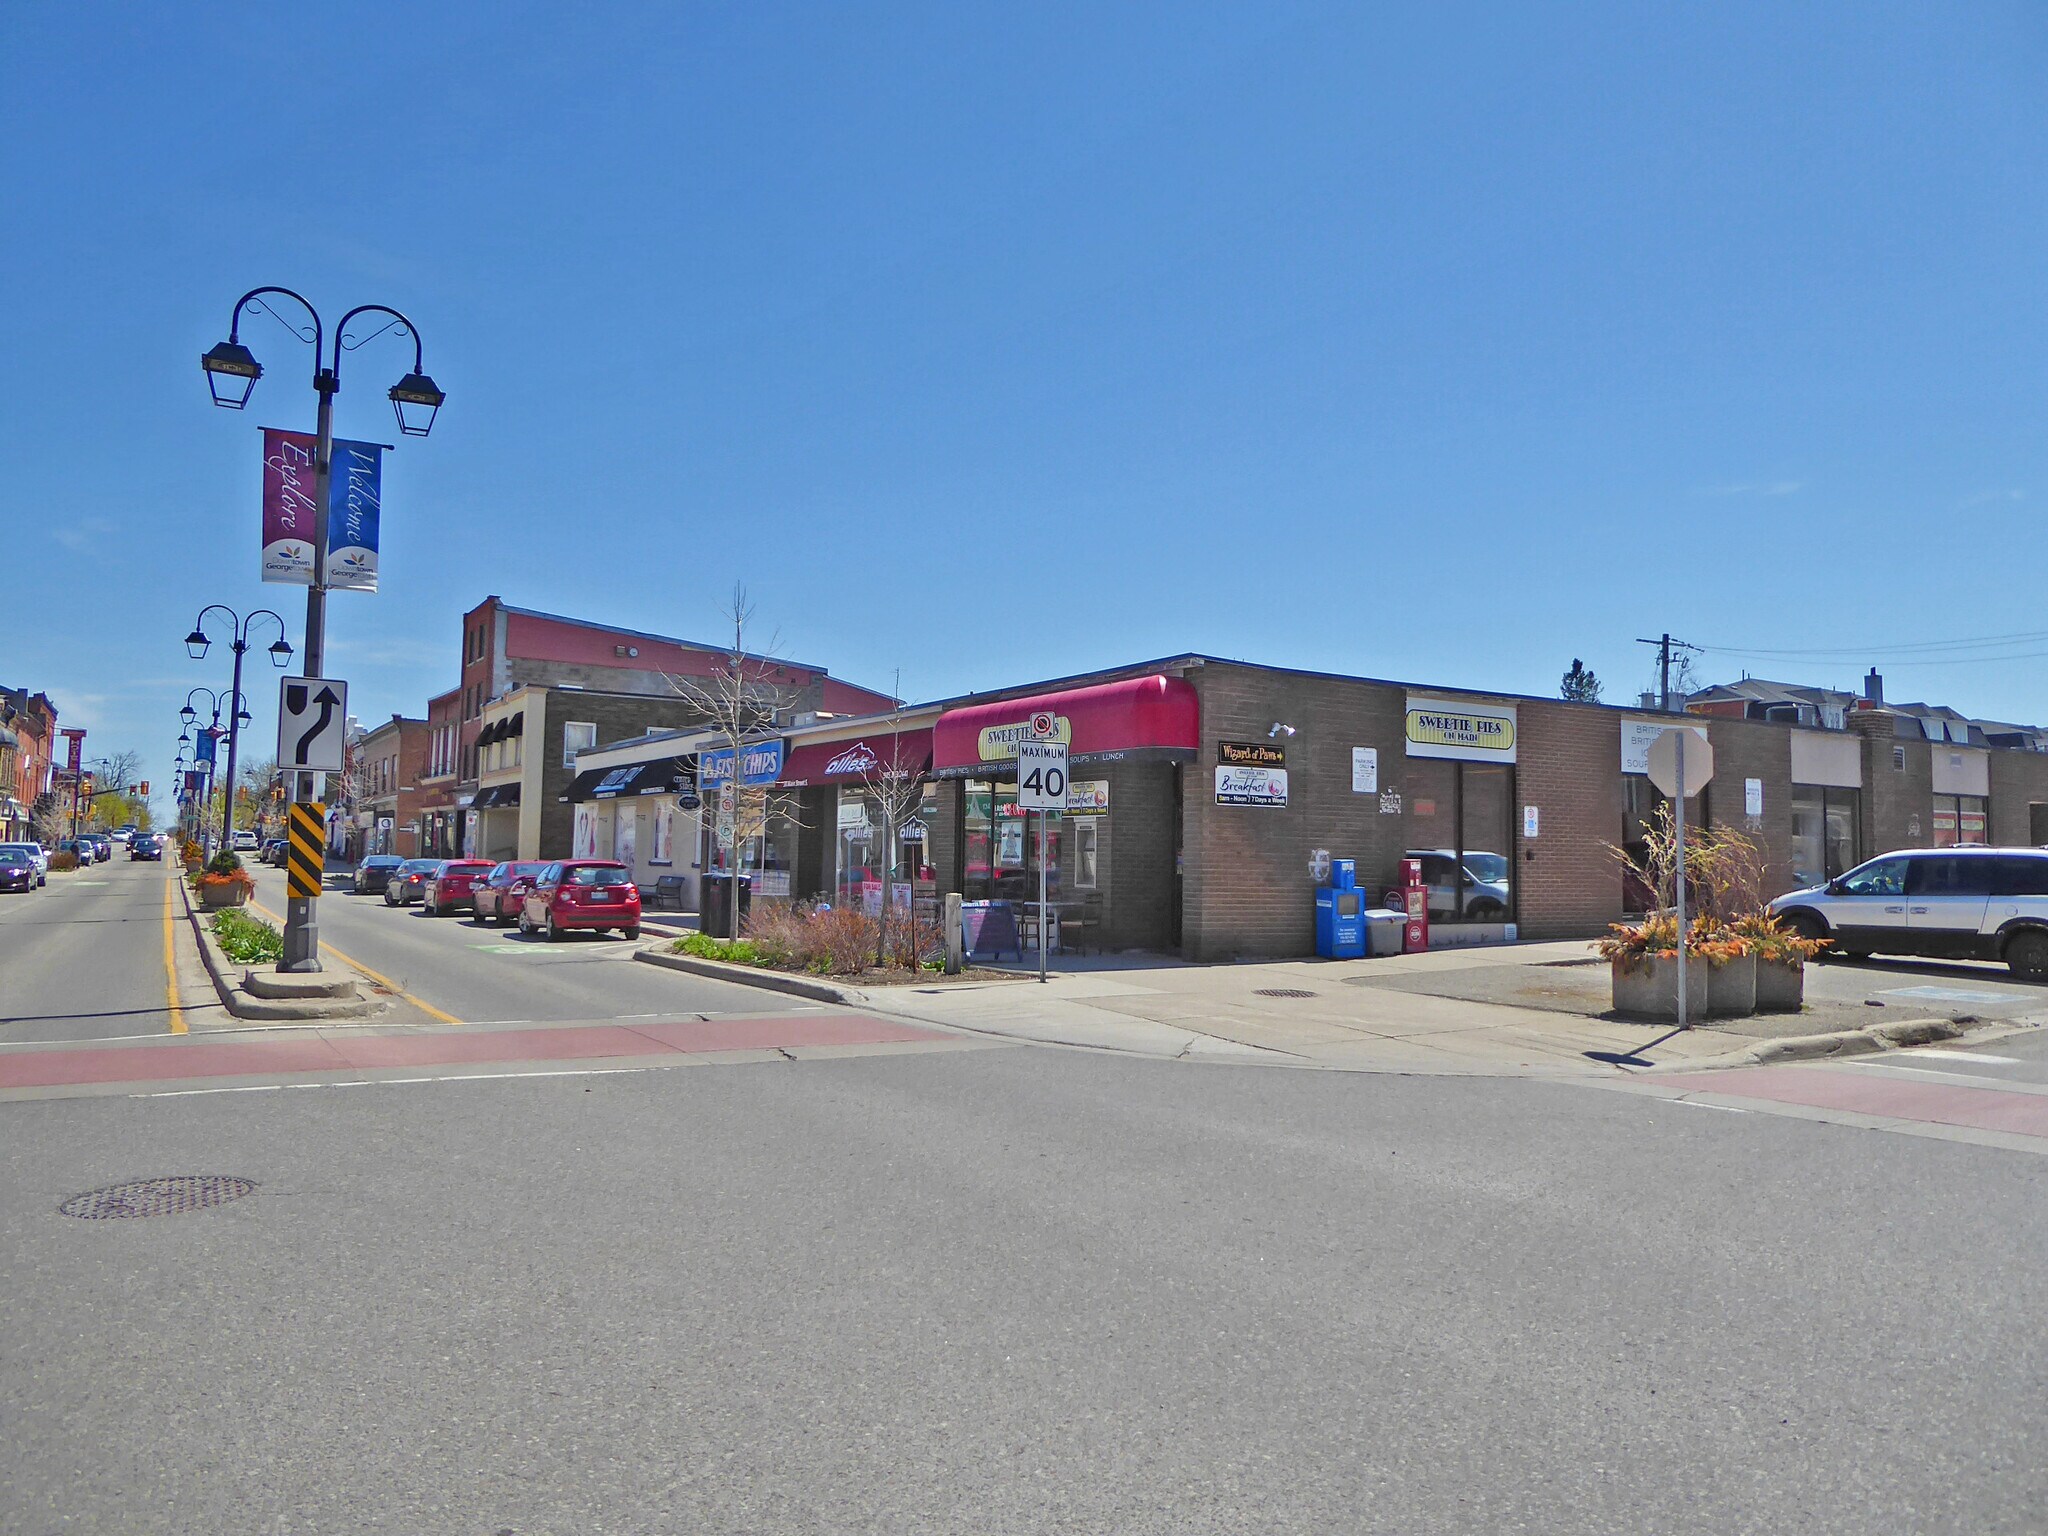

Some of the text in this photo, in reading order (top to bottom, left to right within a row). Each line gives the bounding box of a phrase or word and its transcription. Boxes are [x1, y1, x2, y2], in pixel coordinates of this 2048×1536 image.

[264, 441, 317, 531] Explore
[348, 449, 381, 543] Welcome
[1419, 716, 1501, 734] SWEETIE PIES
[1636, 725, 1663, 735] BRITIS
[988, 726, 1031, 744] SWEETIE
[1444, 731, 1478, 742] ON MAIN
[1631, 737, 1657, 746] BRITI
[1021, 745, 1065, 760] MAXIMUM
[1223, 745, 1276, 760] Wizard of Paws
[717, 751, 778, 778] FIS CHIPS
[957, 766, 970, 775] PIES
[977, 763, 997, 773] BRITISH
[998, 762, 1018, 771] GOODS
[1069, 755, 1090, 764] SOUPS
[1102, 752, 1124, 761] LUNCH
[1022, 767, 1064, 798] 40
[1220, 775, 1266, 796] Breakfast
[1068, 790, 1094, 808] reakfast
